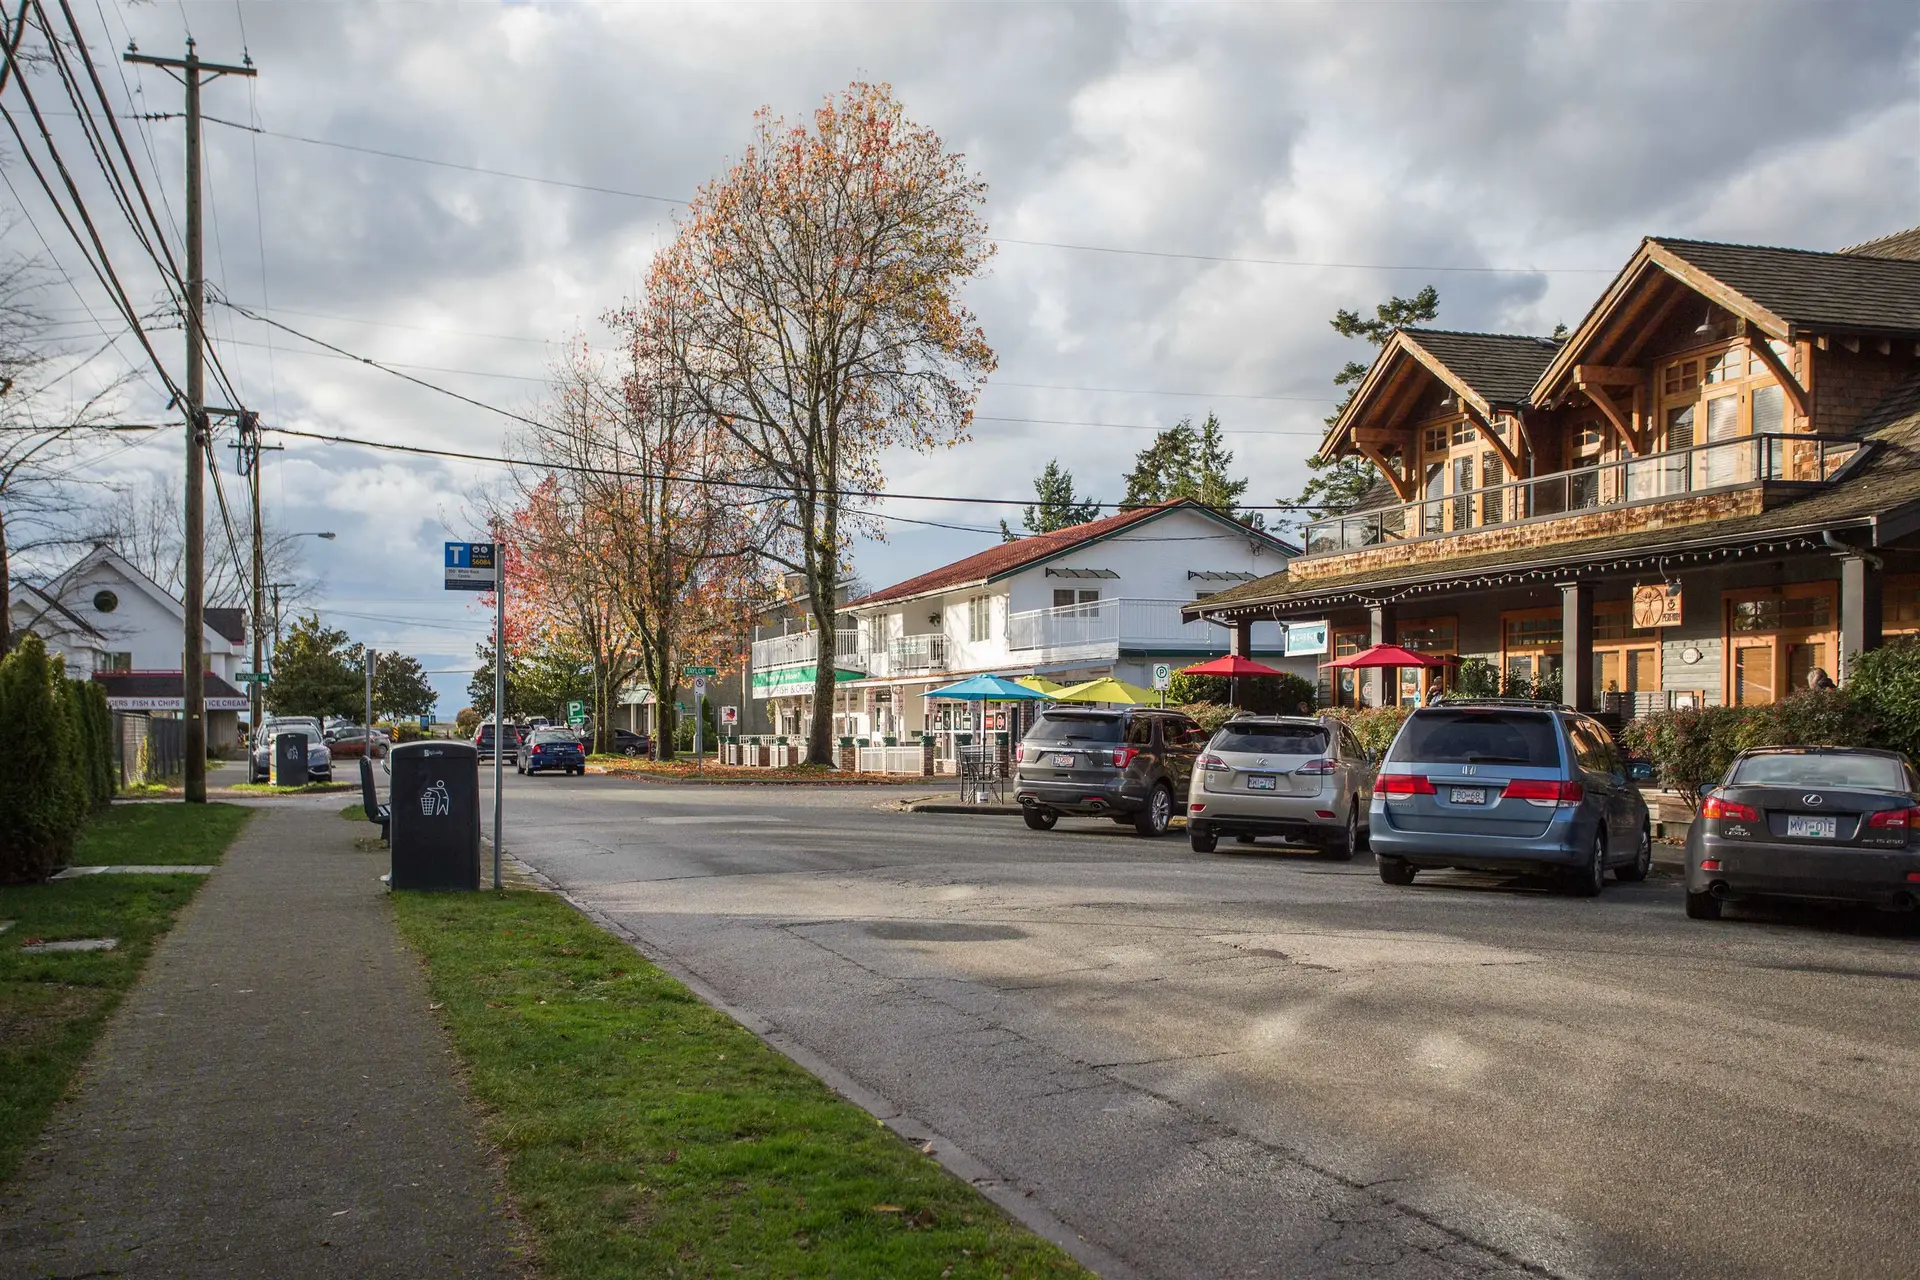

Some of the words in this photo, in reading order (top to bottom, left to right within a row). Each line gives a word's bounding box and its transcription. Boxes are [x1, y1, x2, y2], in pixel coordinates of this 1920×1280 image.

[686, 667, 707, 675] TAYLOR
[776, 685, 789, 695] FISH
[790, 684, 796, 694] &
[569, 702, 581, 716] P
